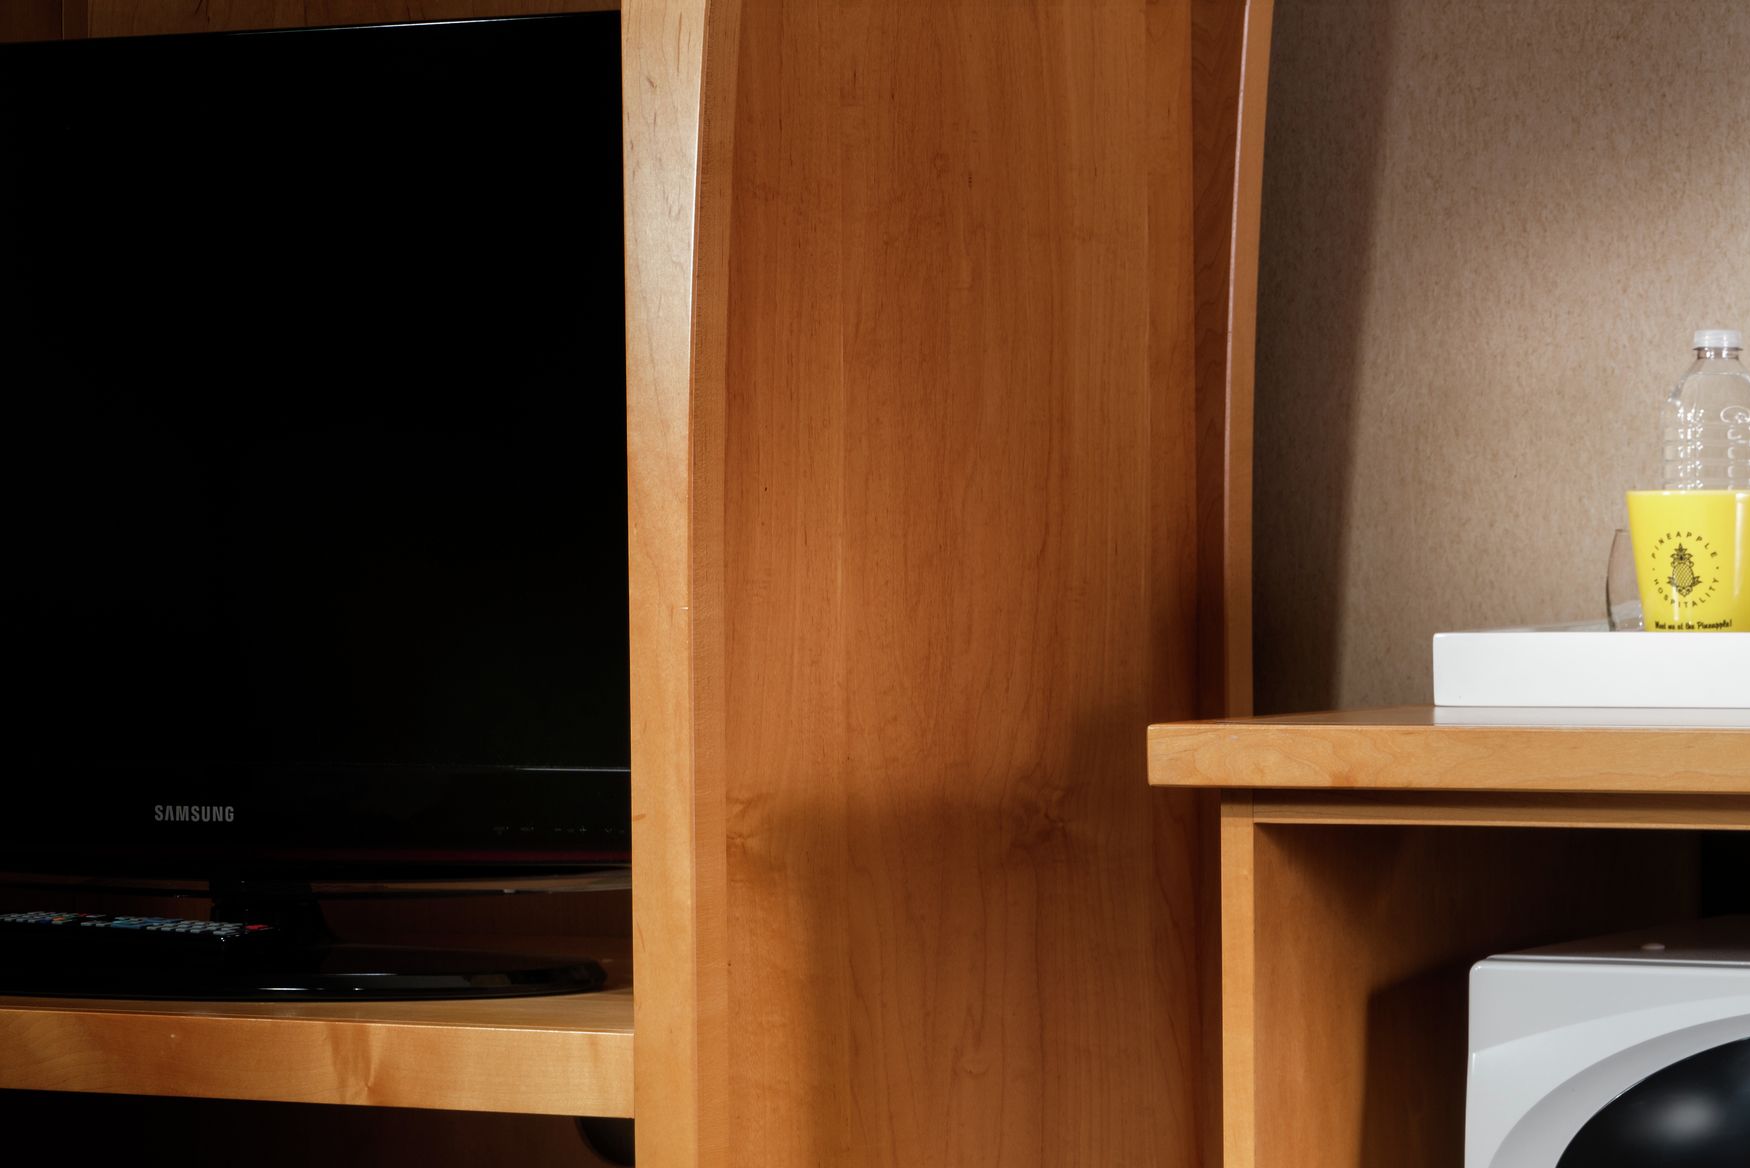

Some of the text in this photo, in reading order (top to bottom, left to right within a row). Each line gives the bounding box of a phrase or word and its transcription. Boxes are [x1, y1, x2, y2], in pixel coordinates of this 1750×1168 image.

[1651, 531, 1718, 559] PINEAPPLE
[1653, 578, 1719, 608] HOSPITALITY
[155, 805, 234, 822] SAMSUNG
